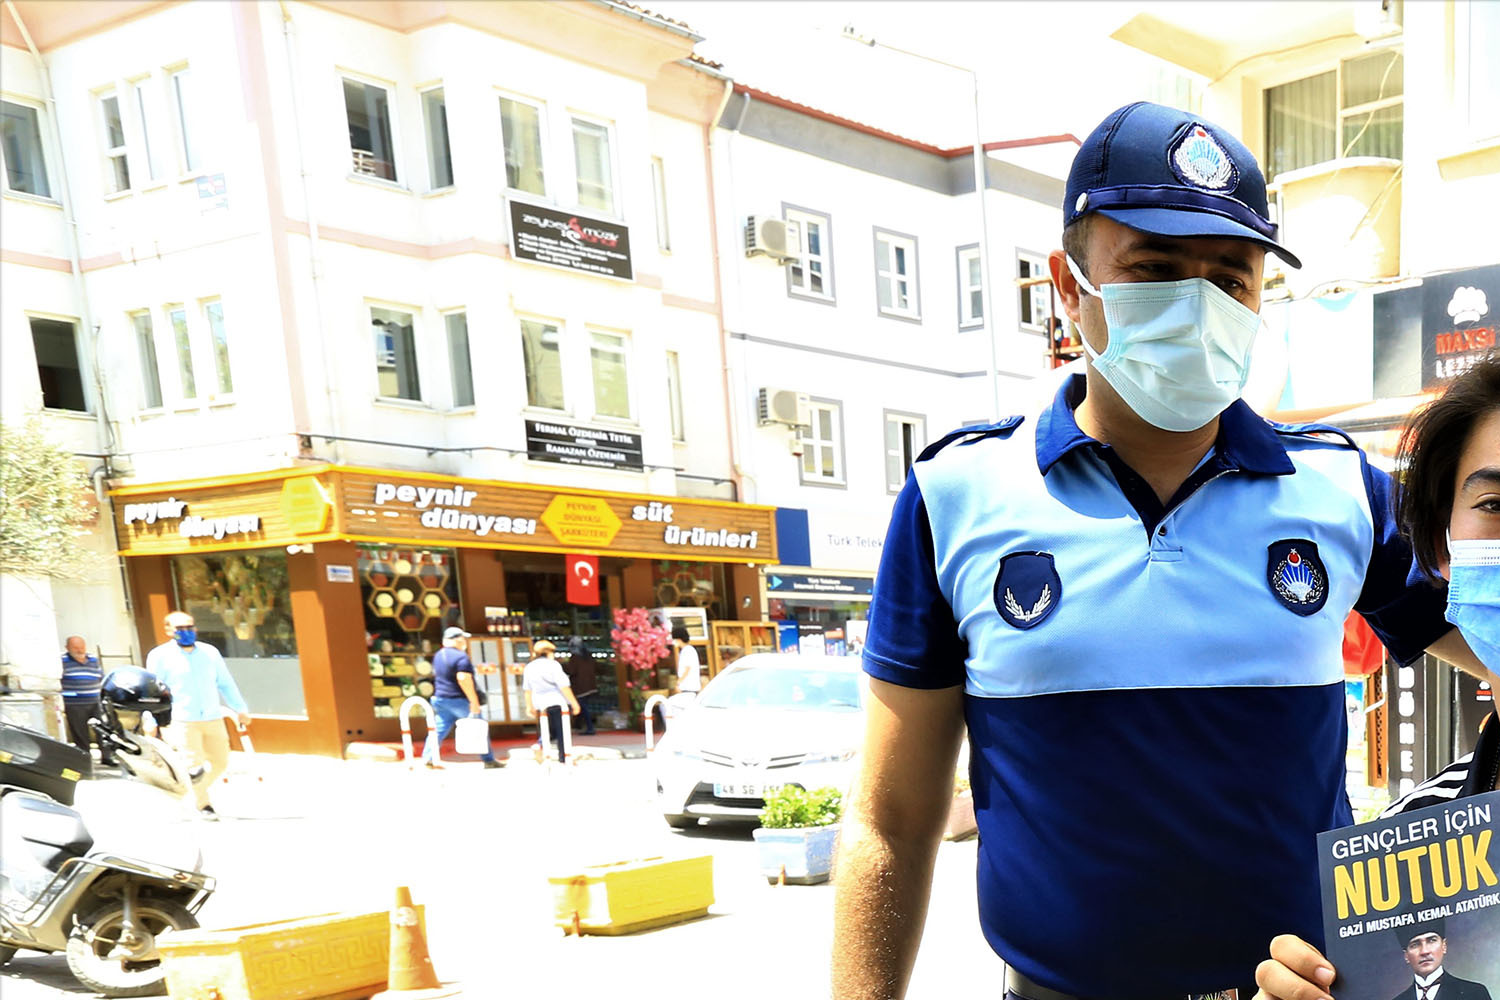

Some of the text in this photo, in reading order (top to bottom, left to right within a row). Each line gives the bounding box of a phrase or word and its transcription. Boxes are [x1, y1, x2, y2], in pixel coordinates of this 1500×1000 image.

[1435, 351, 1496, 379] LEZZ
[545, 443, 586, 458] RAMAZAN
[375, 483, 478, 509] peynir
[124, 497, 187, 525] peynir
[421, 507, 537, 536] dünyası
[632, 501, 674, 523] süt
[664, 524, 758, 549] ürünleri
[1331, 803, 1492, 860] GENÇLER İÇİN
[1333, 829, 1499, 920] NUTUK
[1339, 892, 1500, 939] GAZİ MUSTAFA KEMAL ATATÜRK
